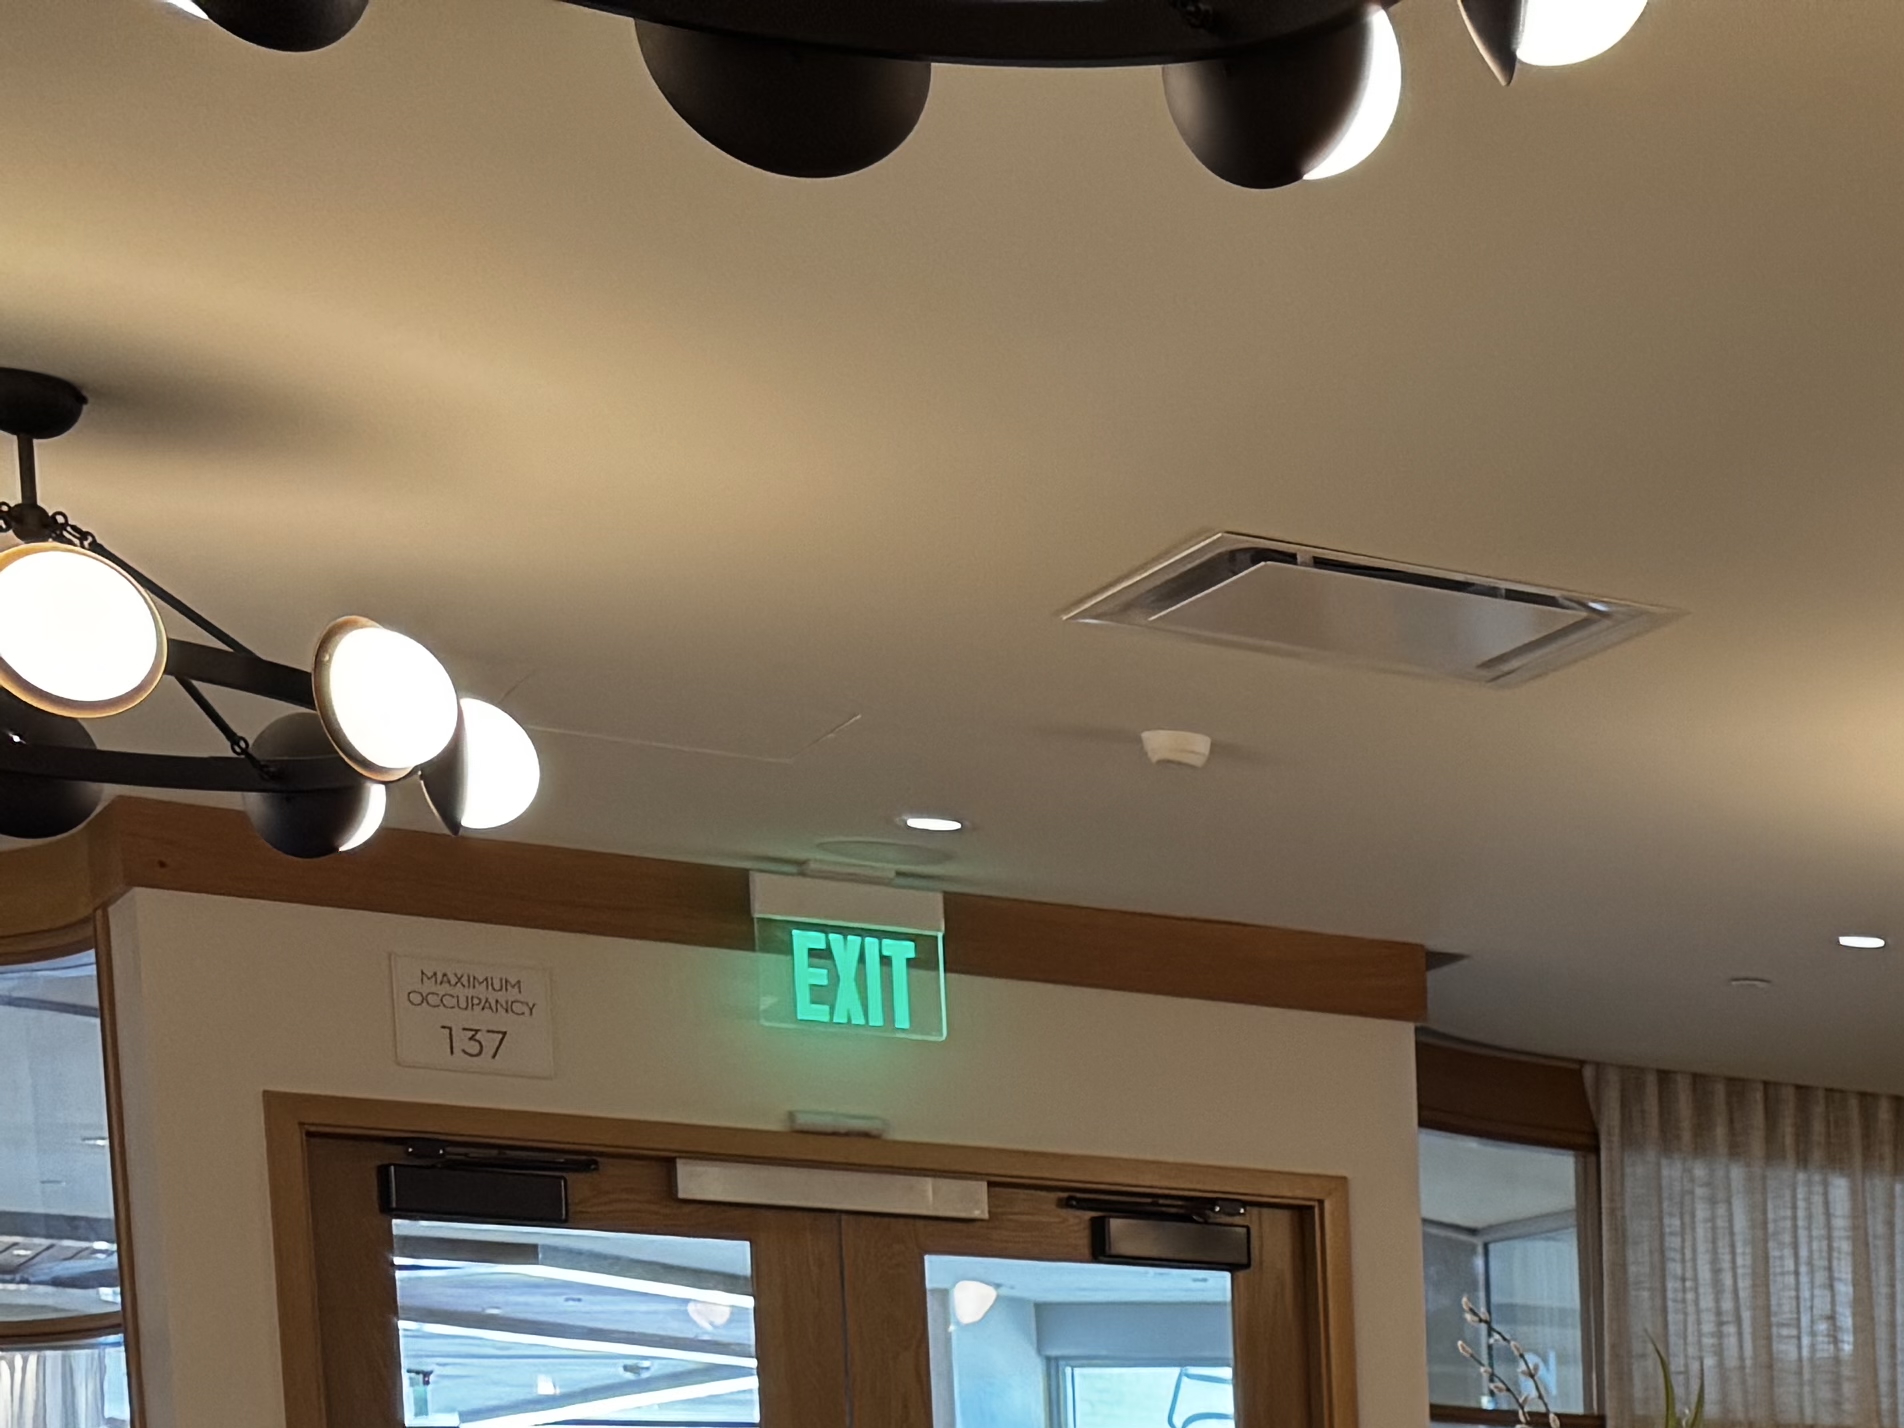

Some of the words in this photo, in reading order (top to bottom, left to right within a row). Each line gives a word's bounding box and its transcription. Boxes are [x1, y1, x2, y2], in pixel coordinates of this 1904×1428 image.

[420, 968, 522, 994] MAXIMUM
[791, 929, 915, 1029] EXIT
[407, 990, 537, 1016] OCCUPANCY
[440, 1025, 508, 1060] 137
